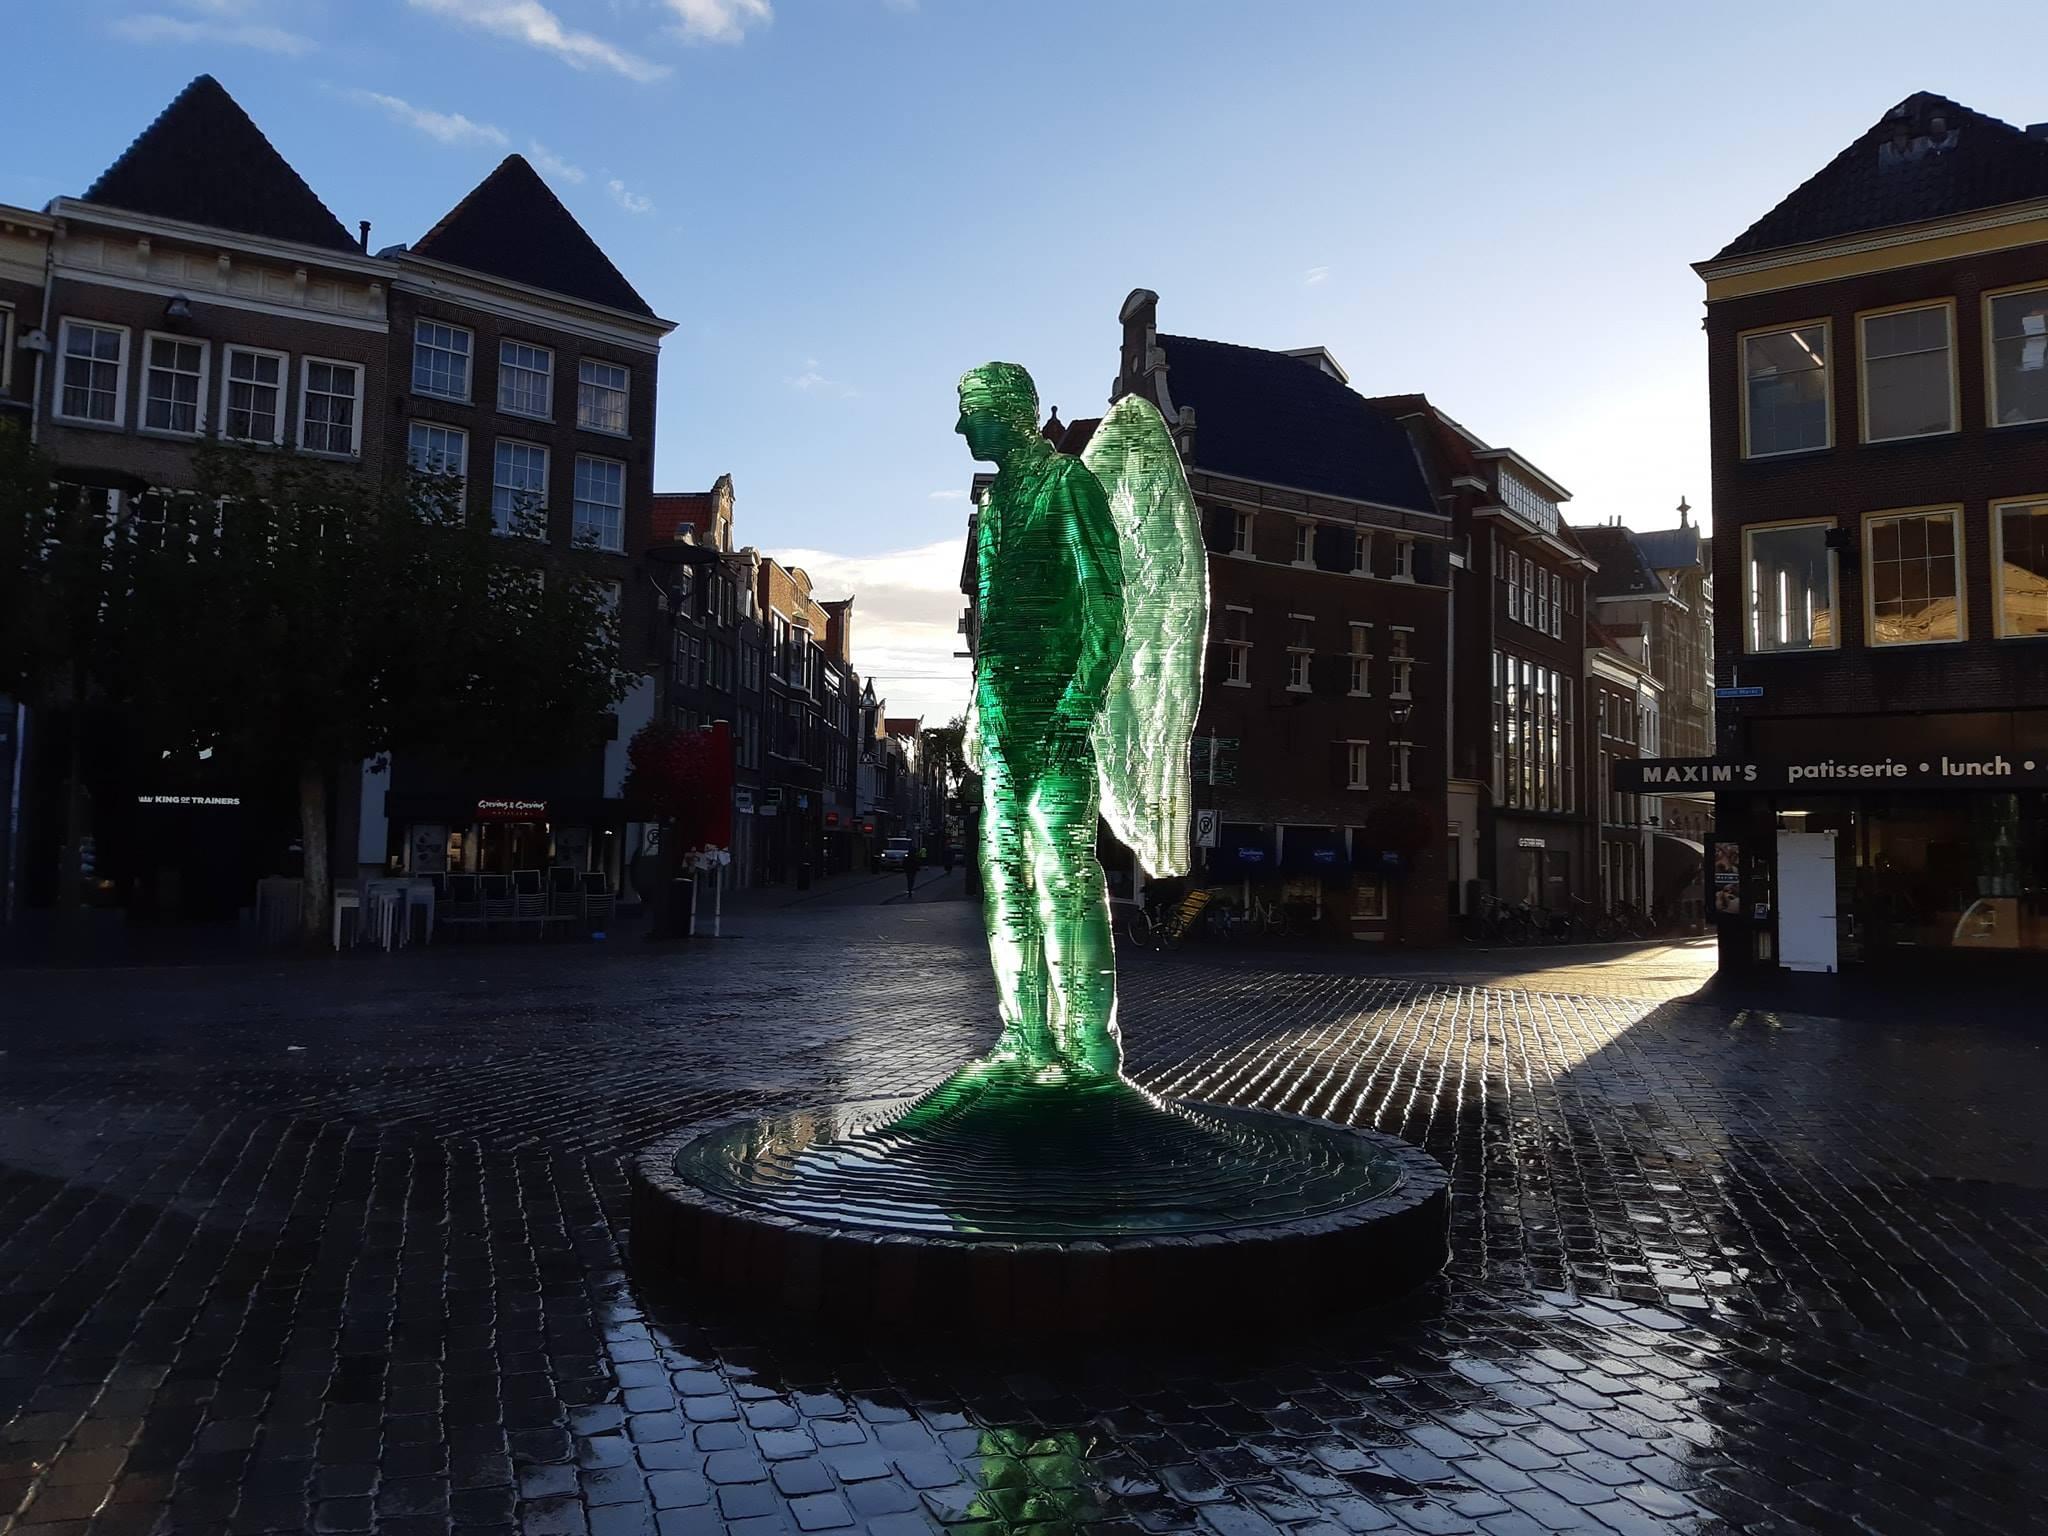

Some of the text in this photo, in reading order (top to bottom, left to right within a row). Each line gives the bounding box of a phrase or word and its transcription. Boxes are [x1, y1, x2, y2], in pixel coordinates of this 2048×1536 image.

[1642, 756, 2011, 784] MAXIM'S patisserie lunch
[154, 795, 180, 804] KING
[190, 796, 240, 805] TRAINERS
